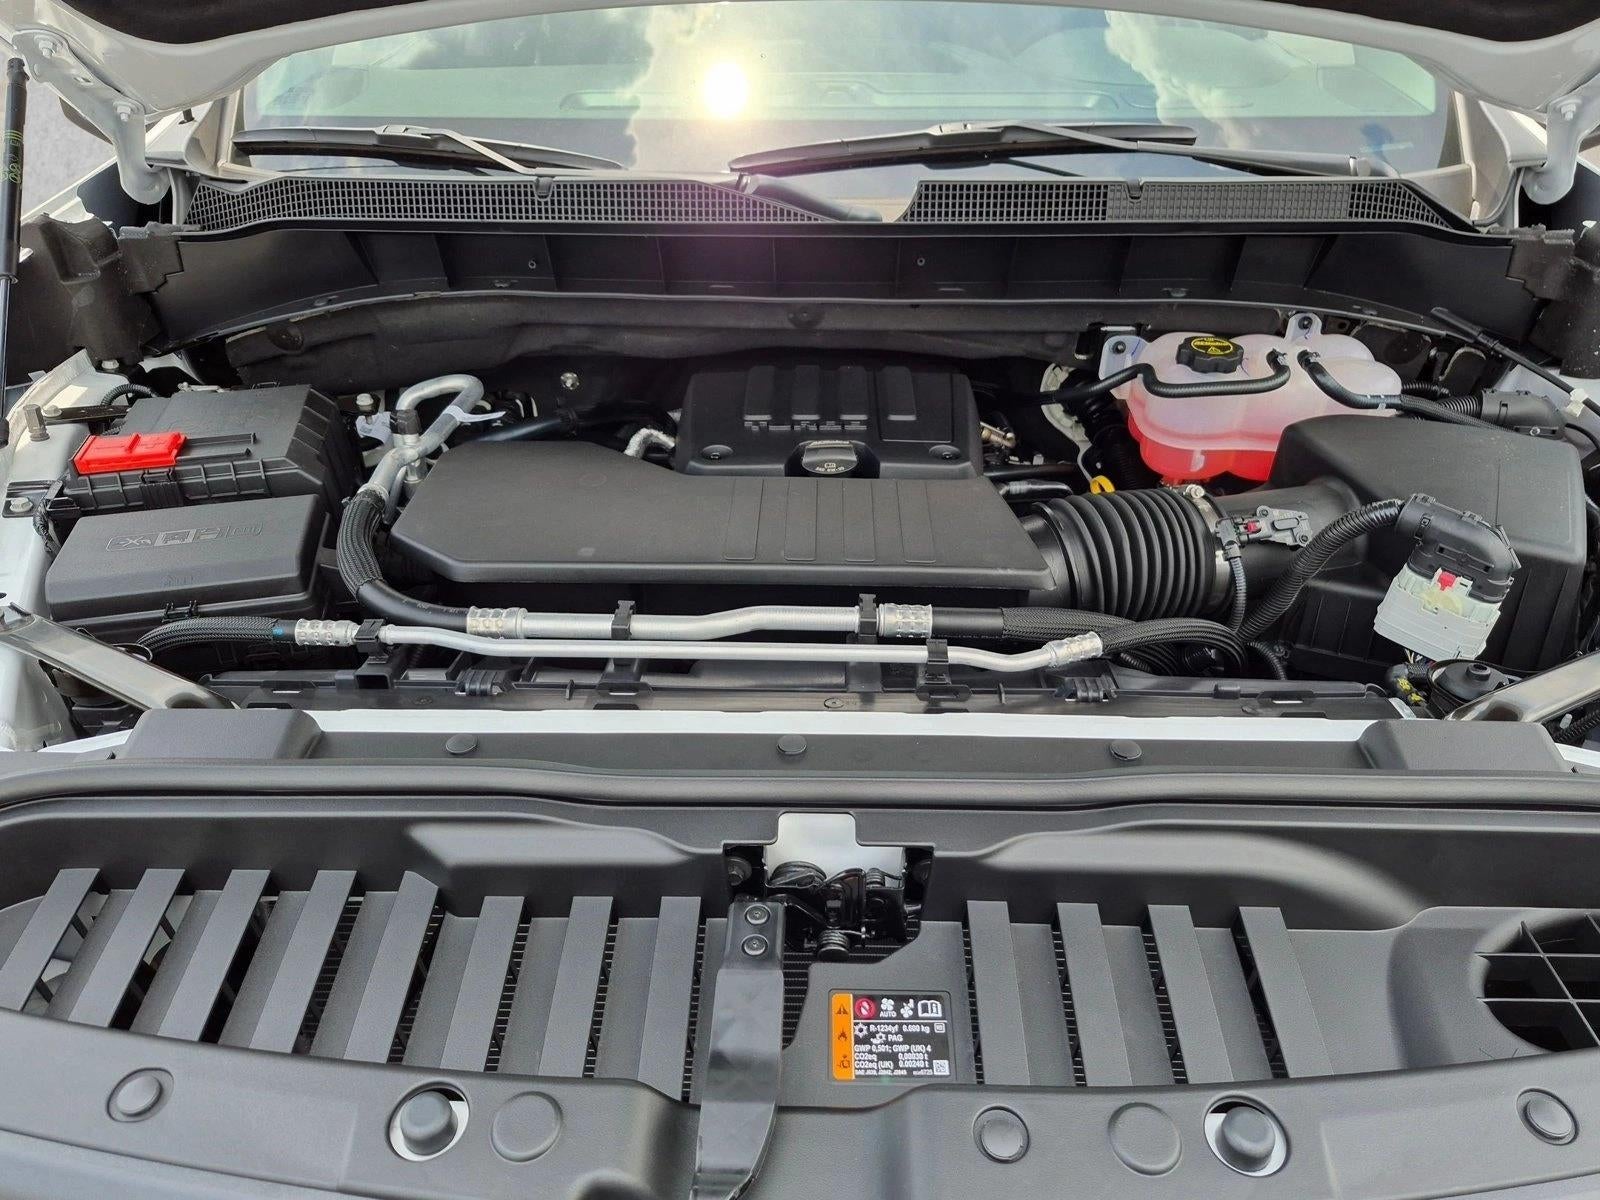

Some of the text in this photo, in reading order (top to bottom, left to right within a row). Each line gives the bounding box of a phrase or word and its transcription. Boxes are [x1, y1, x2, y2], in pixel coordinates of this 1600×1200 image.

[869, 1024, 898, 1033] R-1234yf
[920, 1024, 930, 1034] kg
[887, 1034, 903, 1042] PAG
[854, 1044, 871, 1052] GWP
[892, 1044, 910, 1052] GWP
[910, 1044, 926, 1053] (UK)
[854, 1053, 877, 1061] CO2eq
[854, 1061, 877, 1070] CO2eq
[878, 1061, 894, 1069] (UK)
